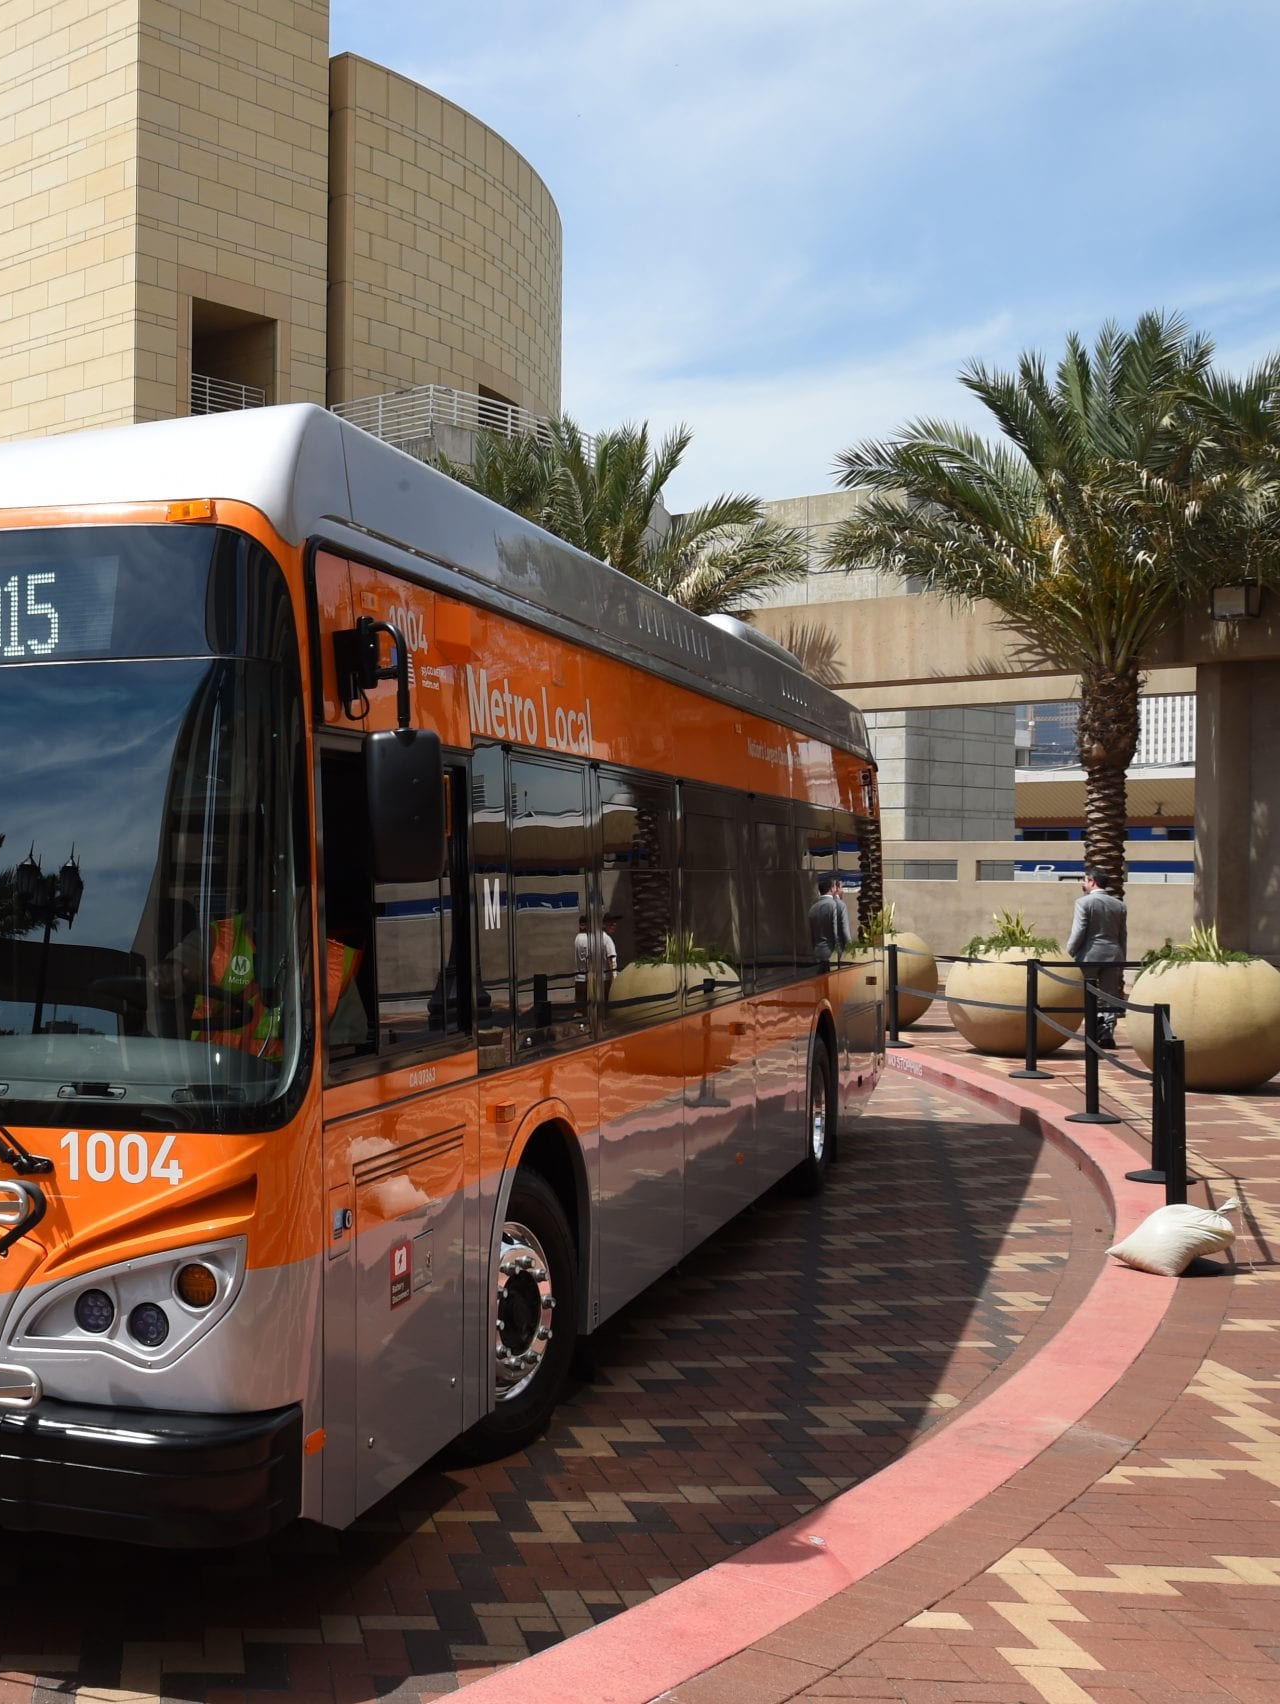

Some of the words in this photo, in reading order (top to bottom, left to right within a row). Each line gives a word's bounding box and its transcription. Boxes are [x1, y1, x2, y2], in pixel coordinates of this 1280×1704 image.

[466, 664, 538, 745] Metro
[541, 687, 593, 755] Local
[484, 878, 501, 930] M
[228, 976, 249, 985] Metro
[60, 1131, 183, 1185] 1004
